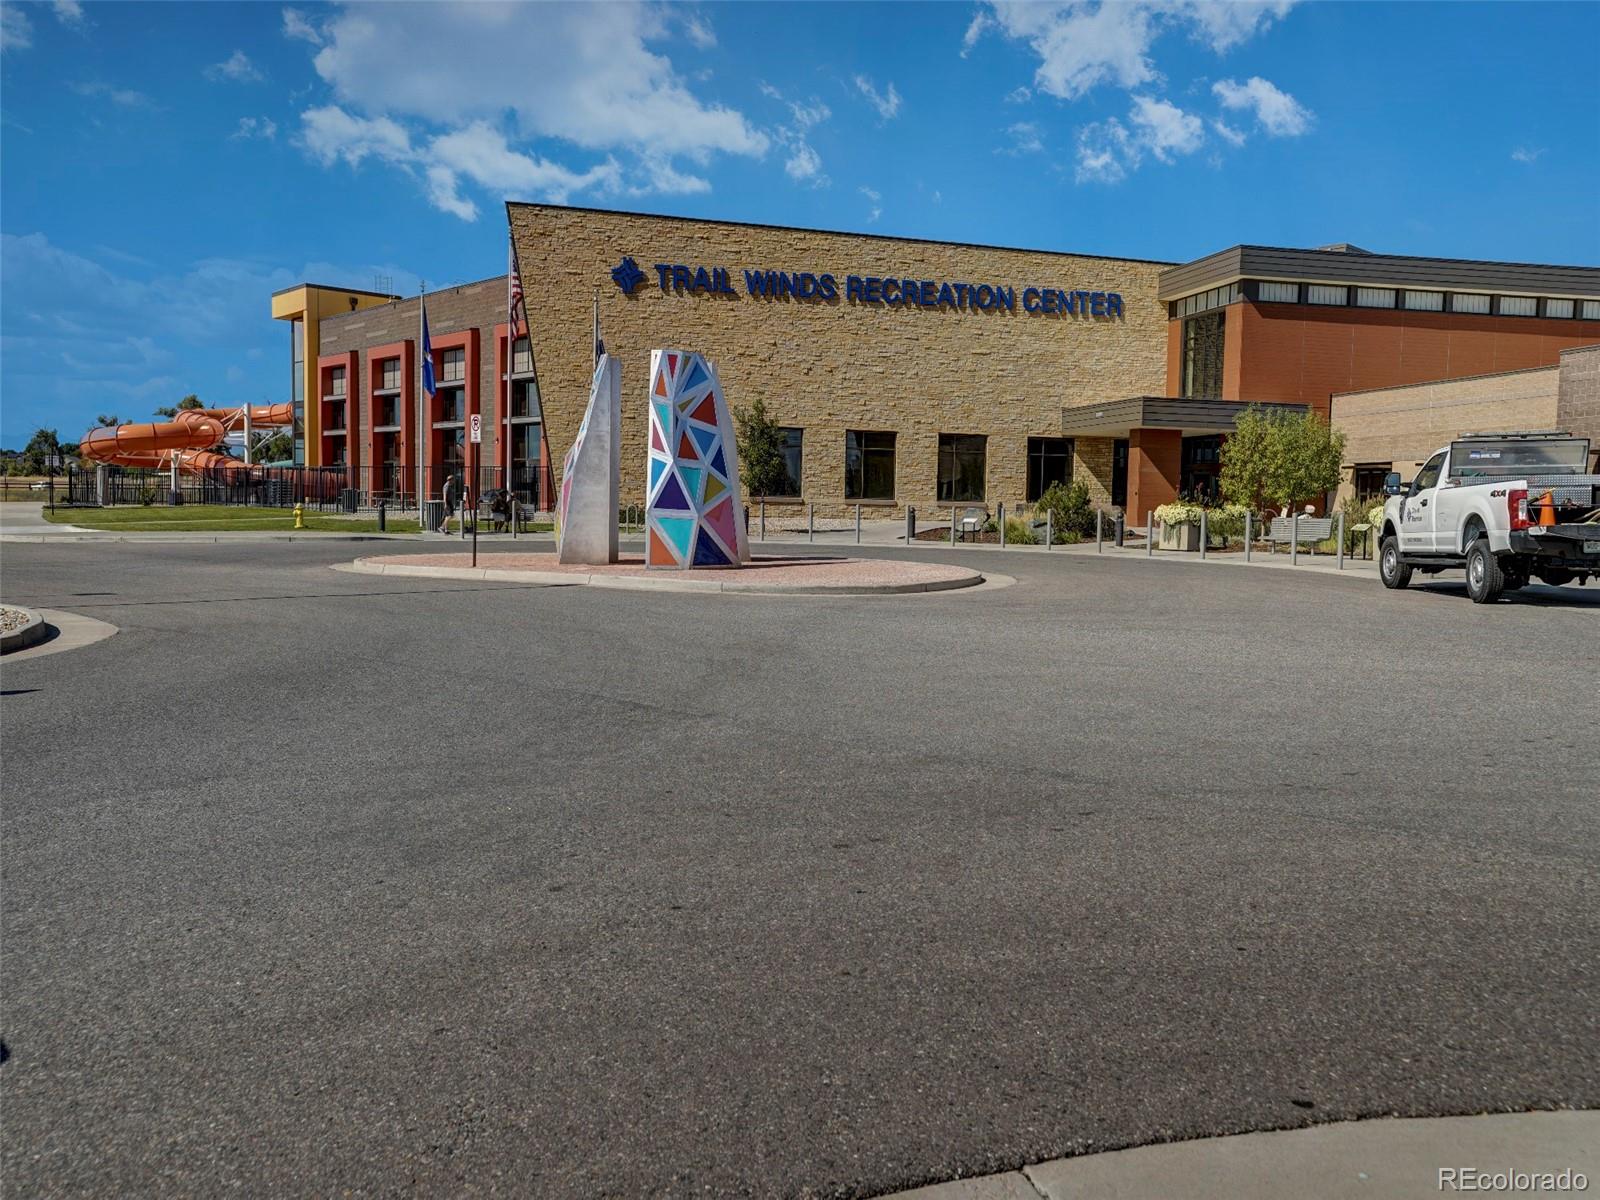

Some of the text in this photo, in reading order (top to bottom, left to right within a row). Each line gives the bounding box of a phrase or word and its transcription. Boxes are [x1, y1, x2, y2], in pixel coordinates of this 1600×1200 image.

[655, 264, 1122, 317] TRAIL WINDS RECREATION CENTER
